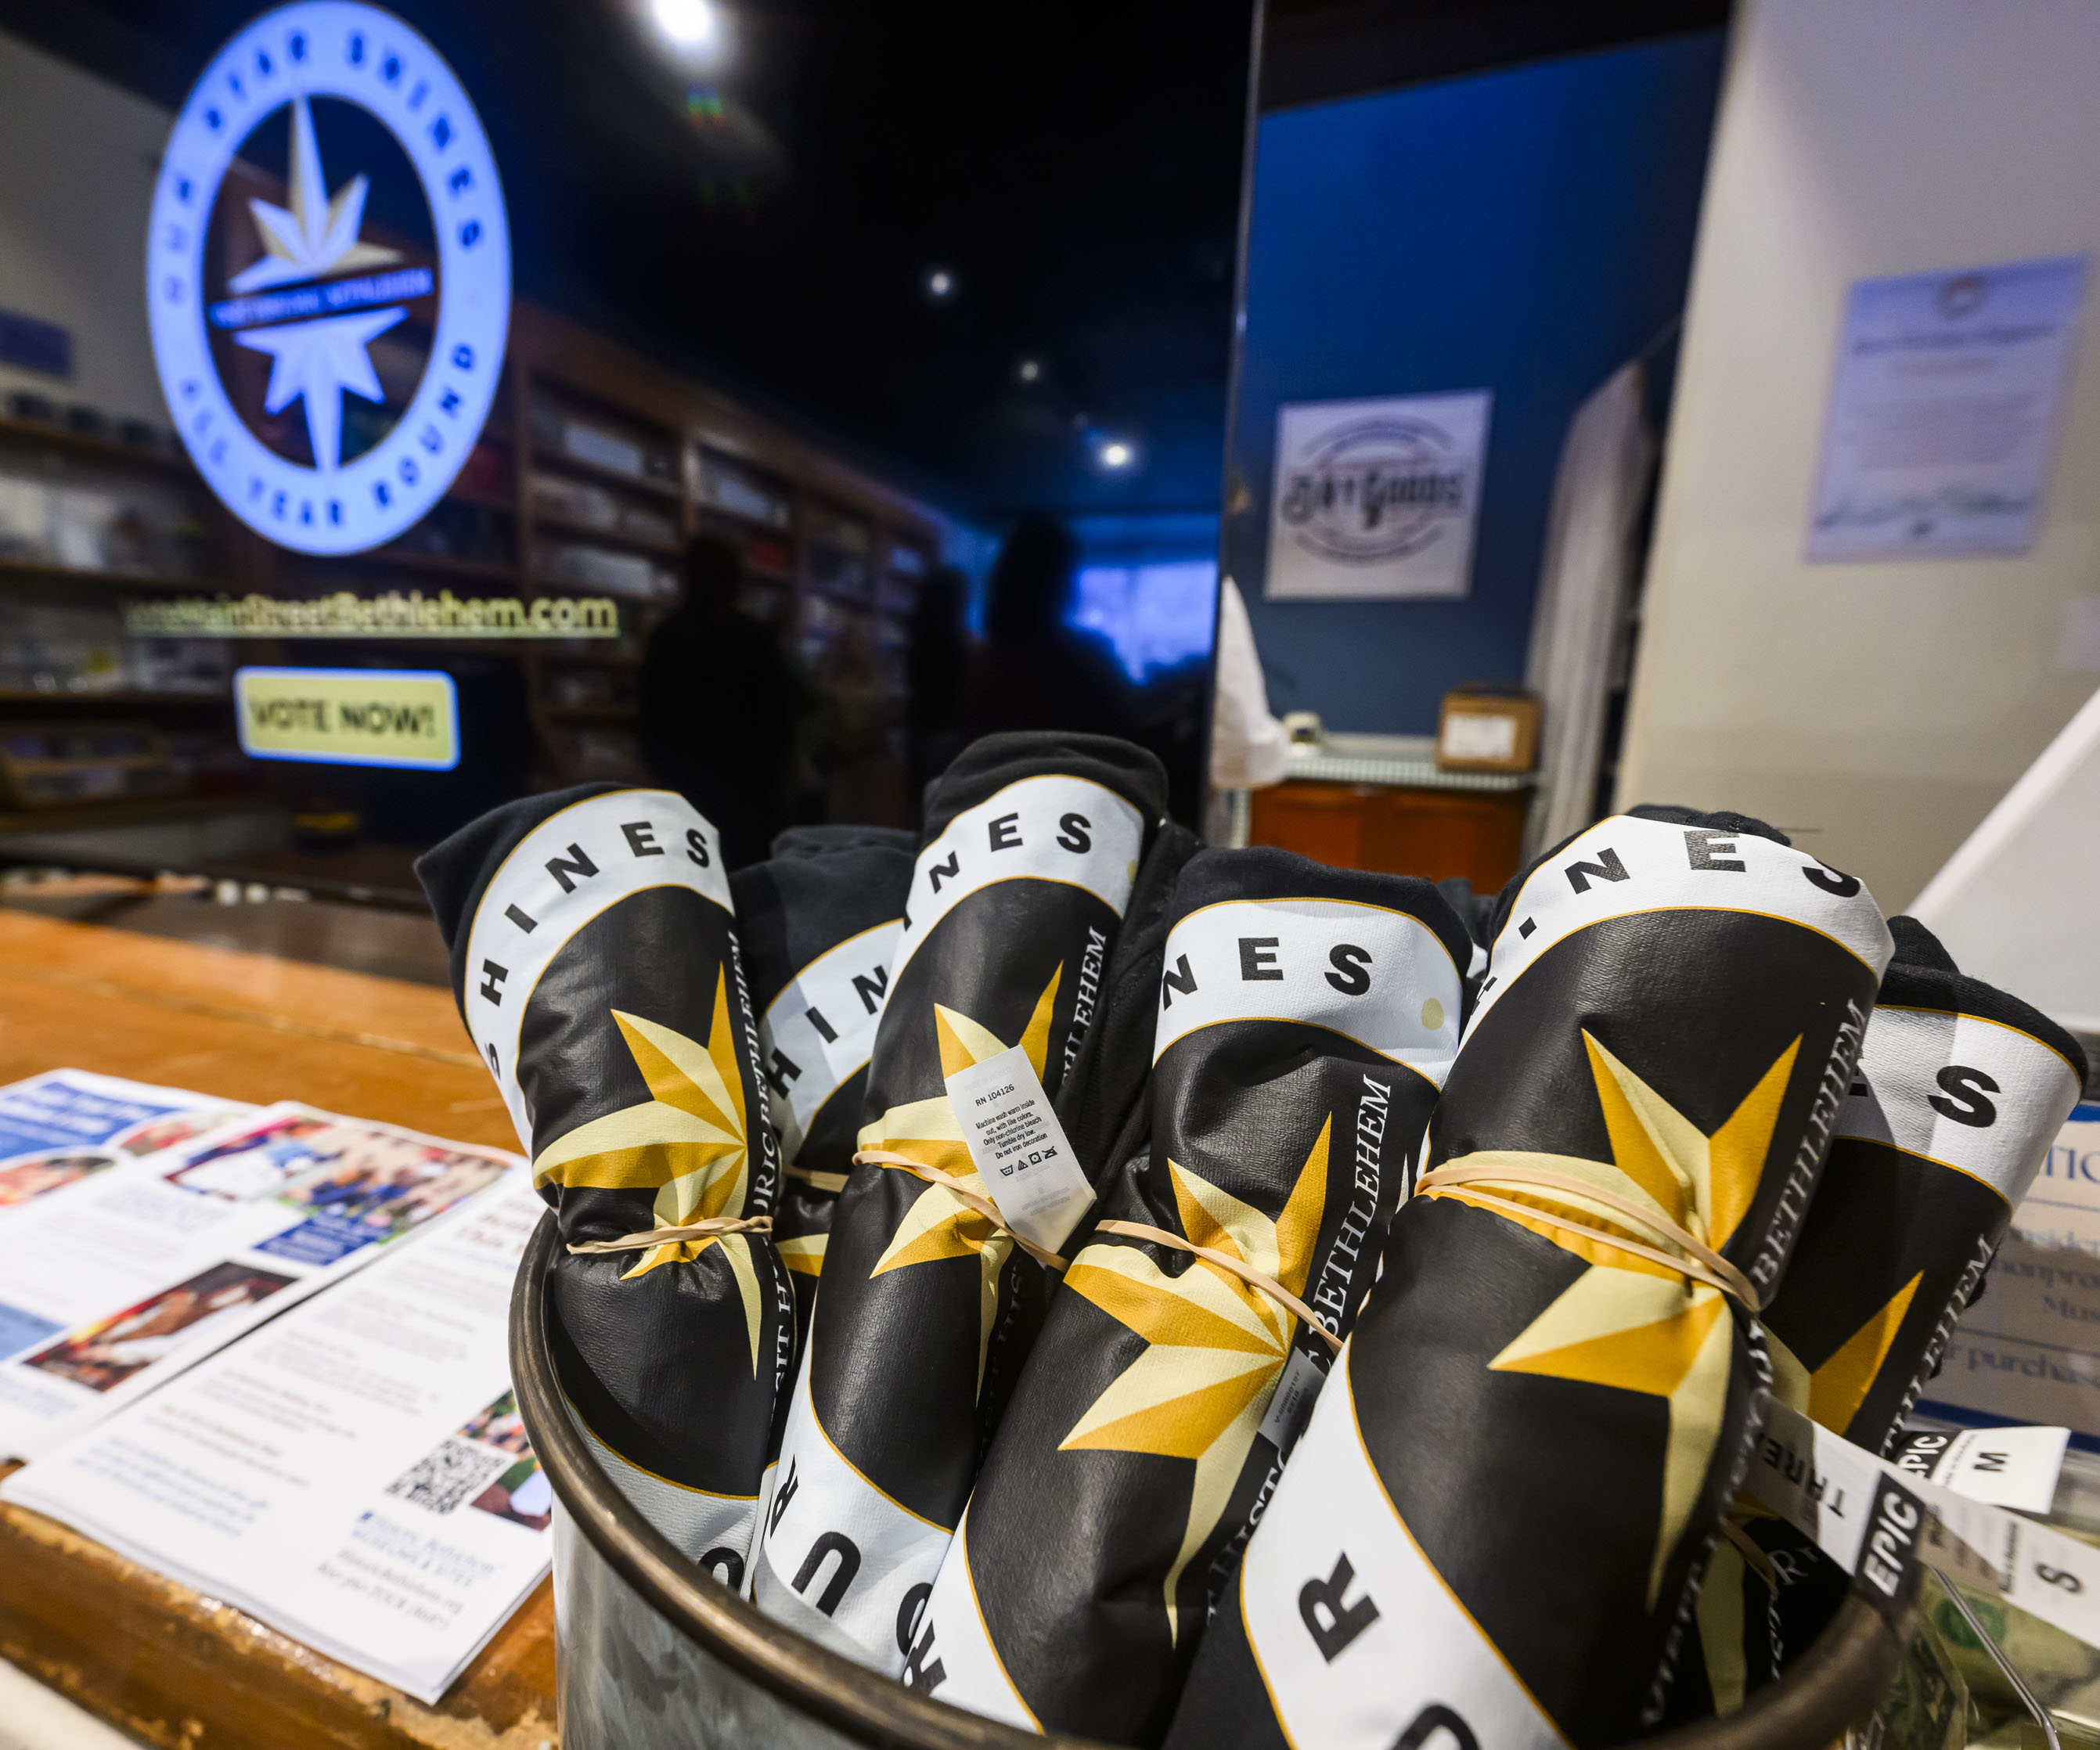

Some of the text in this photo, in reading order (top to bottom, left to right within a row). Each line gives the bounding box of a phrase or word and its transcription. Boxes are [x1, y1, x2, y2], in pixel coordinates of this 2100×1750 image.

[251, 698, 435, 737] VOTE NOW!
[975, 1084, 1014, 1106] RN 104126
[975, 1099, 1036, 1129] Machine wash warm inside
[996, 1122, 1007, 1131] with
[1007, 1117, 1017, 1126] like
[1017, 1111, 1033, 1122] colors.
[983, 1116, 1042, 1146] Only non-chlorine bleach
[997, 1136, 1017, 1148] Tumble
[1003, 1147, 1012, 1156] not
[1012, 1143, 1022, 1152] iron
[1022, 1132, 1048, 1147] decoration
[1308, 1073, 1391, 1344] BETHLEHEM
[1972, 1452, 2011, 1472] M
[1862, 1491, 1919, 1598] EPIC
[2035, 1561, 2084, 1594] S
